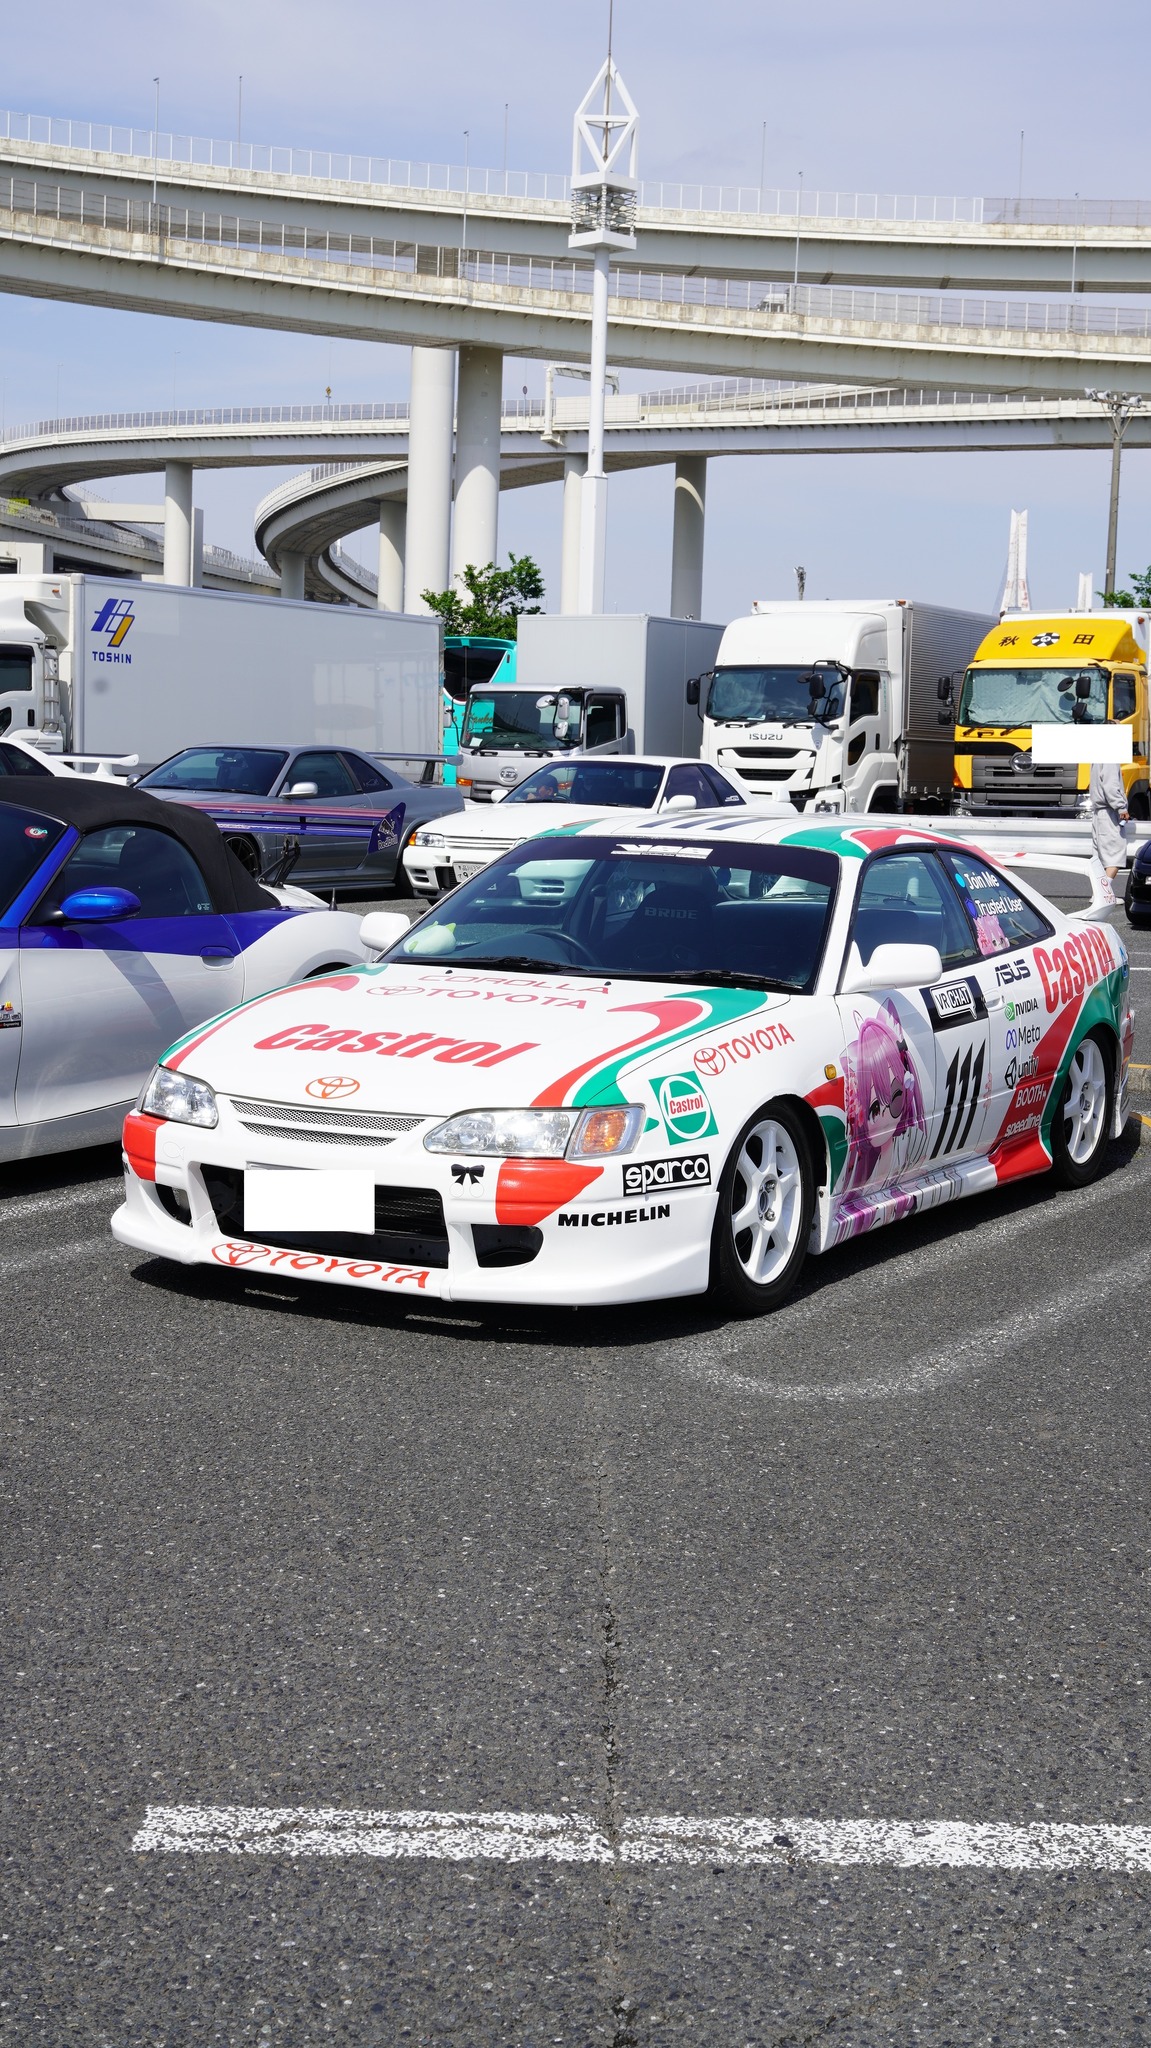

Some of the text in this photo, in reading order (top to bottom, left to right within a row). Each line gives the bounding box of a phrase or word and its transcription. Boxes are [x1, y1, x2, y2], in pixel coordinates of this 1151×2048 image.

[998, 633, 1095, 647] 秋 田
[92, 651, 132, 664] TOSHIN
[749, 733, 783, 741] ISUZU
[964, 871, 1000, 890] Join Me
[644, 906, 699, 920] BRIDE
[975, 896, 1025, 917] Trusted User
[995, 958, 1031, 987] ASUS
[1032, 928, 1116, 1013] Castrol
[418, 974, 611, 995] COROLLA
[430, 987, 588, 1010] TOYOTA
[252, 1023, 542, 1068] Castrol
[717, 1022, 795, 1064] TOYOTA
[1018, 1025, 1041, 1047] Meta
[1018, 1053, 1039, 1079] unity
[669, 1095, 704, 1115] Castrol
[930, 1038, 986, 1160] 111
[1015, 1083, 1045, 1108] BOOTH
[1004, 1112, 1041, 1138] speedline
[625, 1157, 709, 1194] sparco
[558, 1203, 671, 1227] MICHELIN
[269, 1250, 430, 1289] TOYOTA
